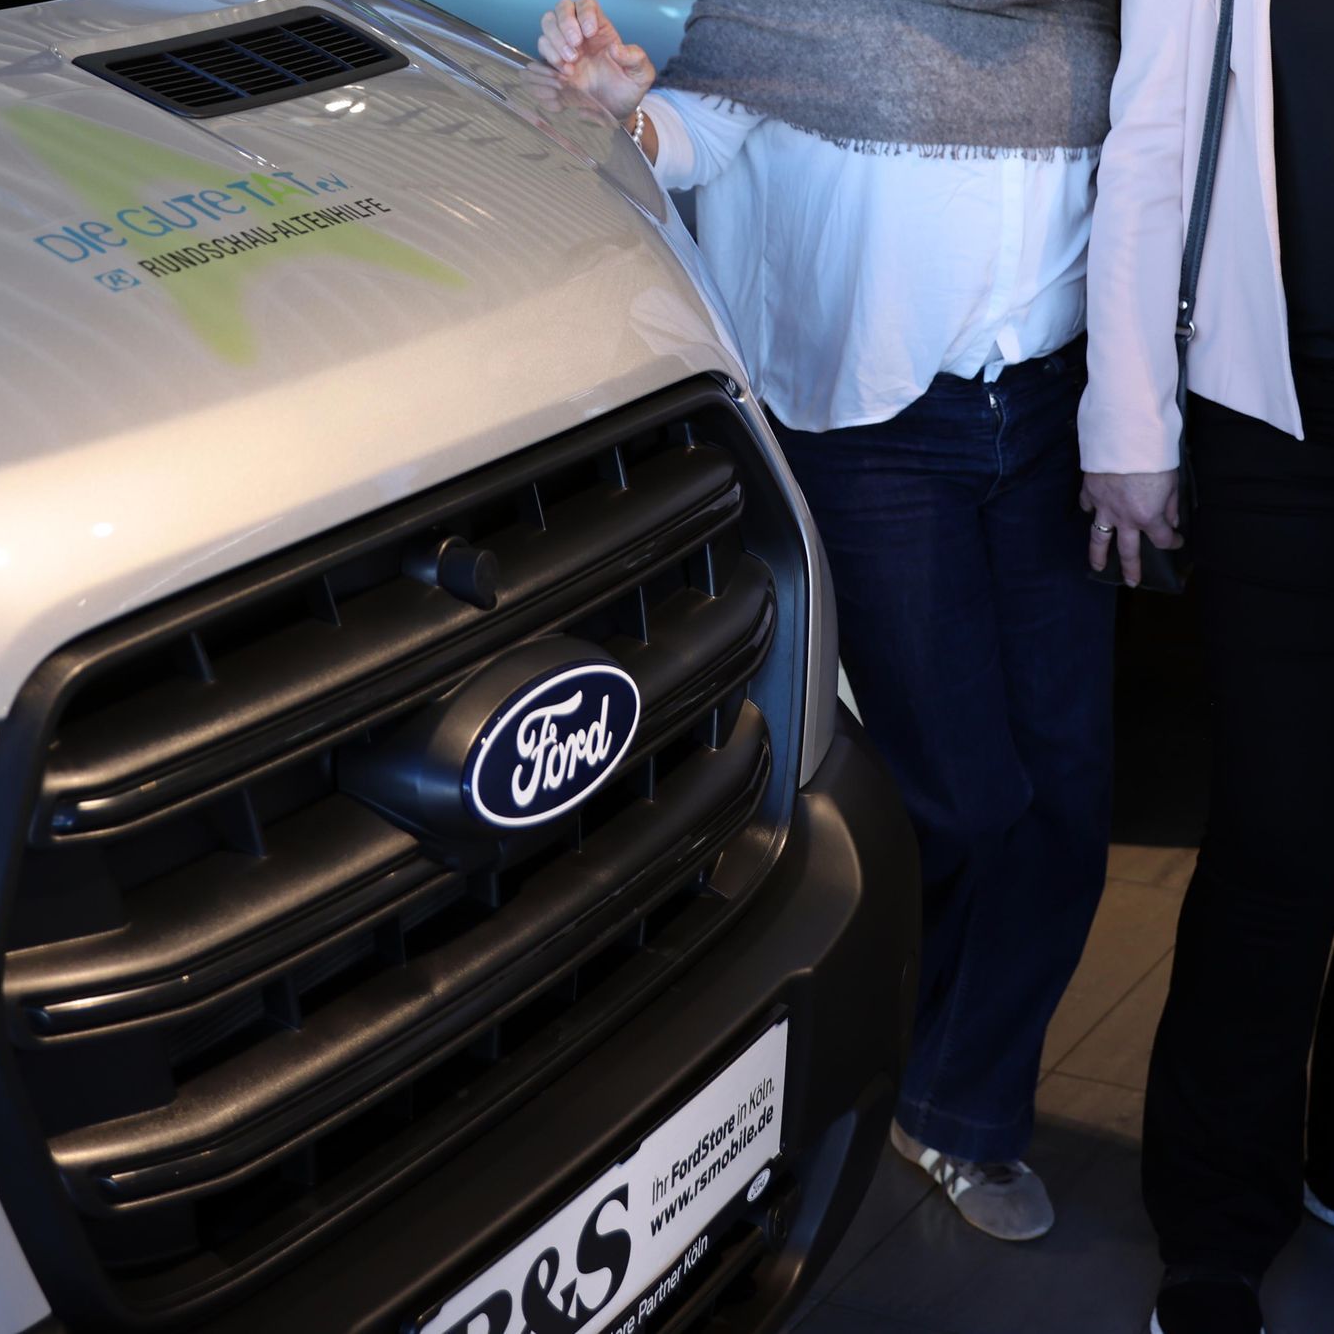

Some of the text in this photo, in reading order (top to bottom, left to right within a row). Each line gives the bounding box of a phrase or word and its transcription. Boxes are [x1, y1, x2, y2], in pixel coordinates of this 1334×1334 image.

[137, 197, 391, 278] RUNDSCHAU-ALTENHILFE
[225, 171, 320, 206] TAT
[511, 689, 612, 806] Ford
[649, 1105, 774, 1238] www.rsmobile.de
[652, 1077, 775, 1206] Ihr FordStore in Köln.
[637, 1264, 682, 1325] Partner
[683, 1234, 708, 1275] Köln
